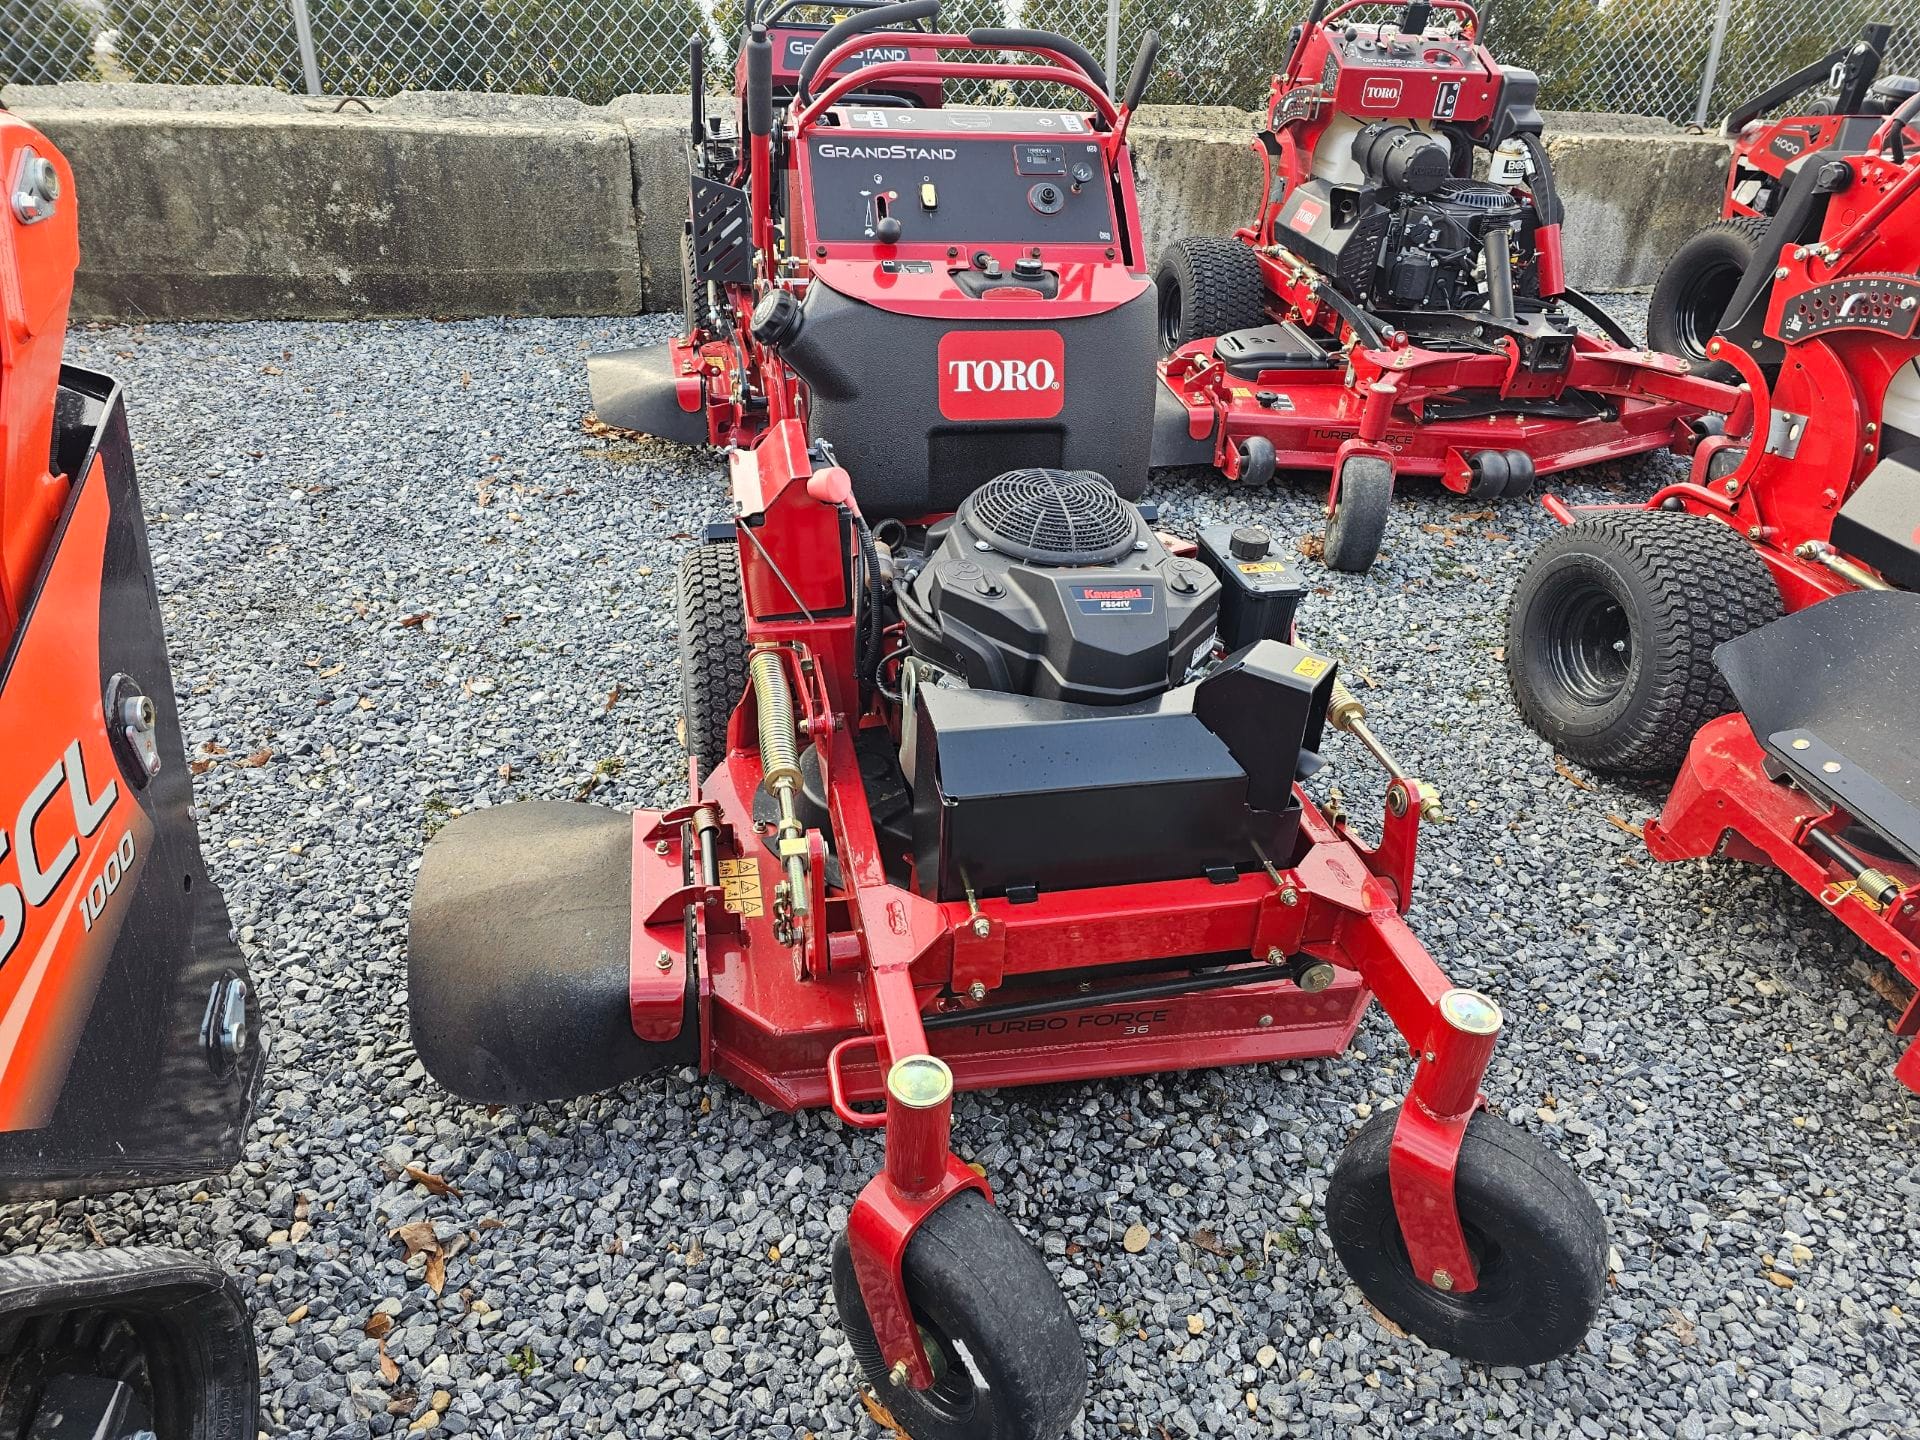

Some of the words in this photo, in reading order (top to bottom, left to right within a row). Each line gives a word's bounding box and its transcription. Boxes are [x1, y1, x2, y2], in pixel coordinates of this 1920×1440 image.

[1367, 87, 1398, 98] TORO
[1774, 136, 1799, 155] 4000
[949, 358, 1056, 392] TORO
[1084, 589, 1142, 599] Kawasaki
[79, 829, 135, 933] 1000
[970, 1017, 1068, 1037] TURBO
[1077, 1009, 1168, 1028] FORCE
[1123, 1025, 1149, 1035] 36
